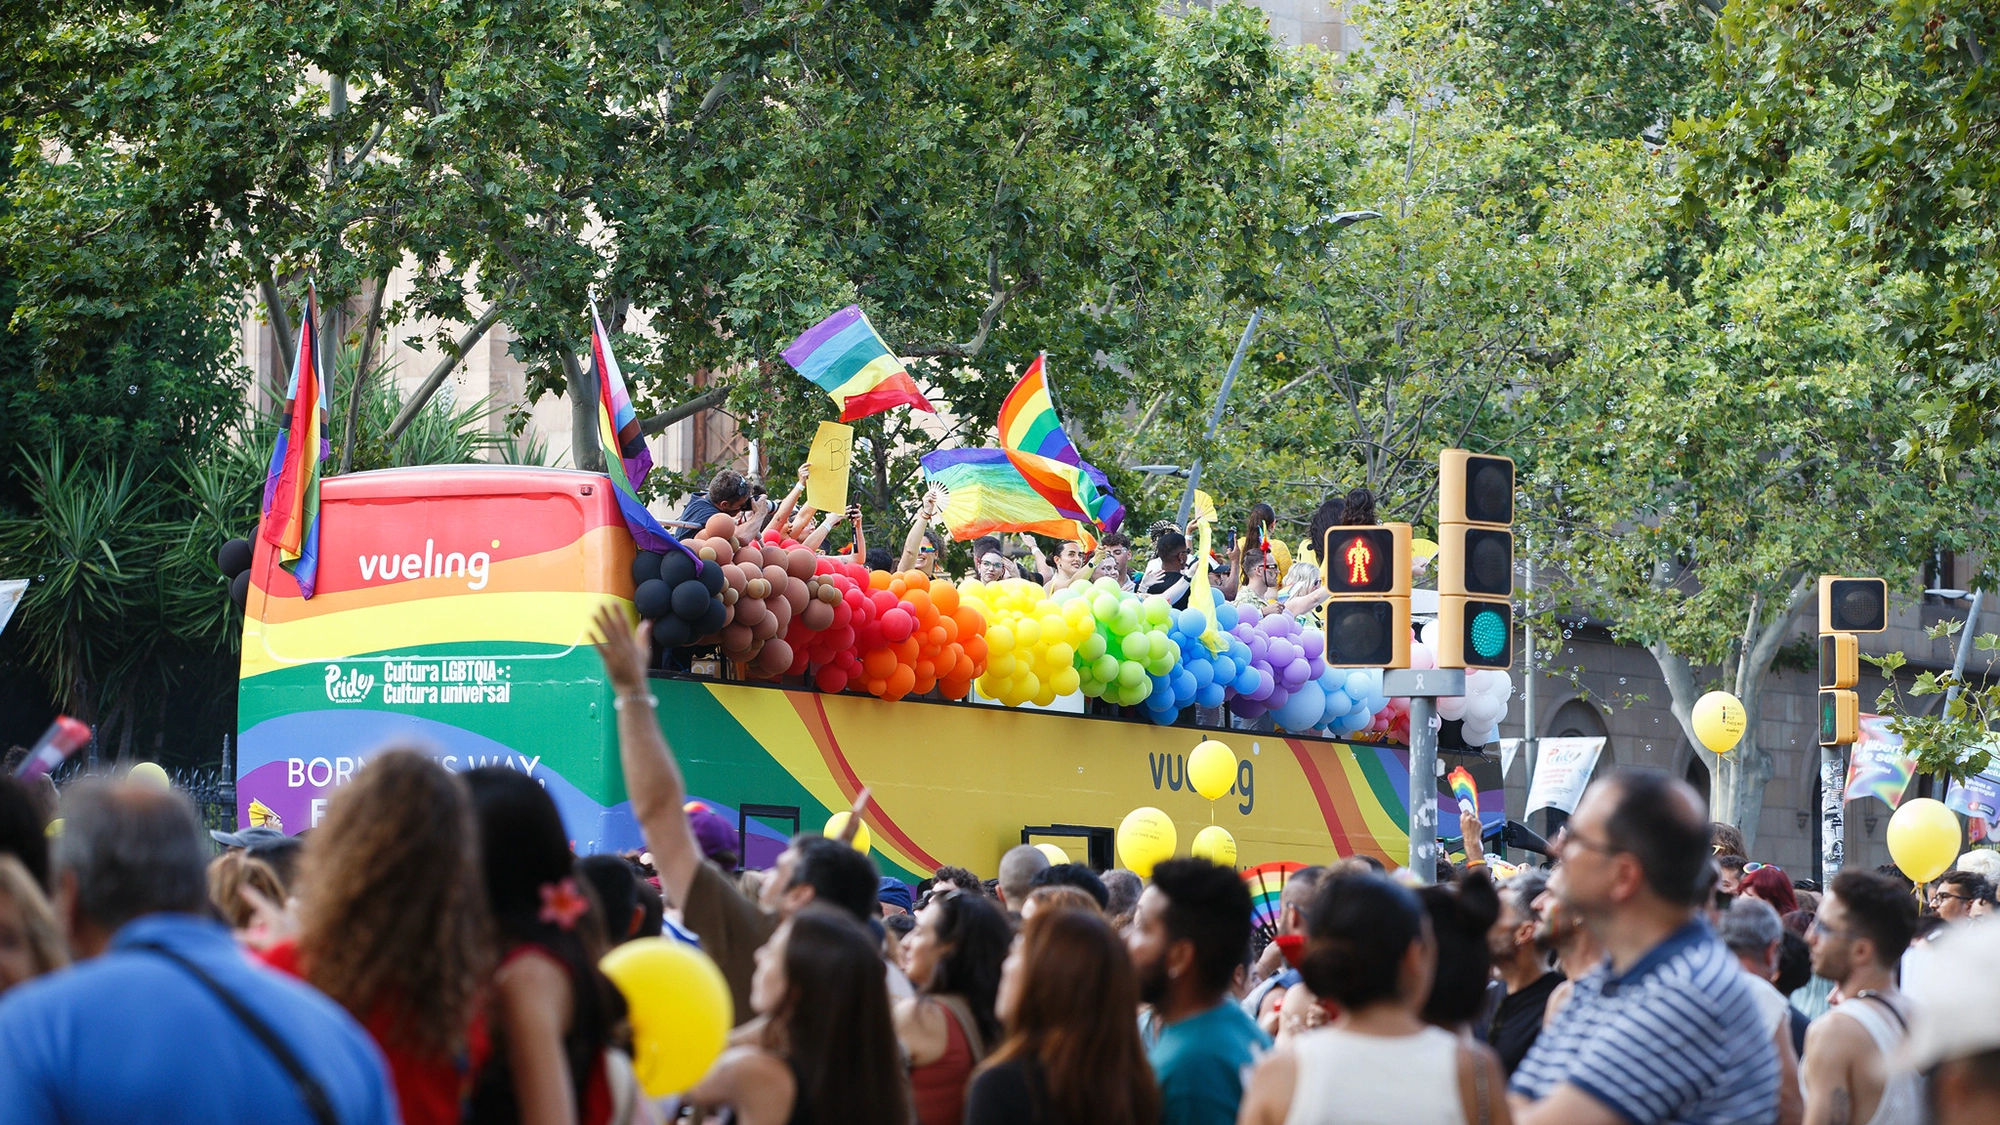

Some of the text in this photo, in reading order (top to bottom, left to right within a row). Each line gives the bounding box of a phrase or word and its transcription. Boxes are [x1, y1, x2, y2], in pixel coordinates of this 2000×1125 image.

[358, 538, 499, 591] vueling
[384, 660, 511, 685] Cultura LGBTQIA+:
[383, 682, 511, 704] Cultura universal
